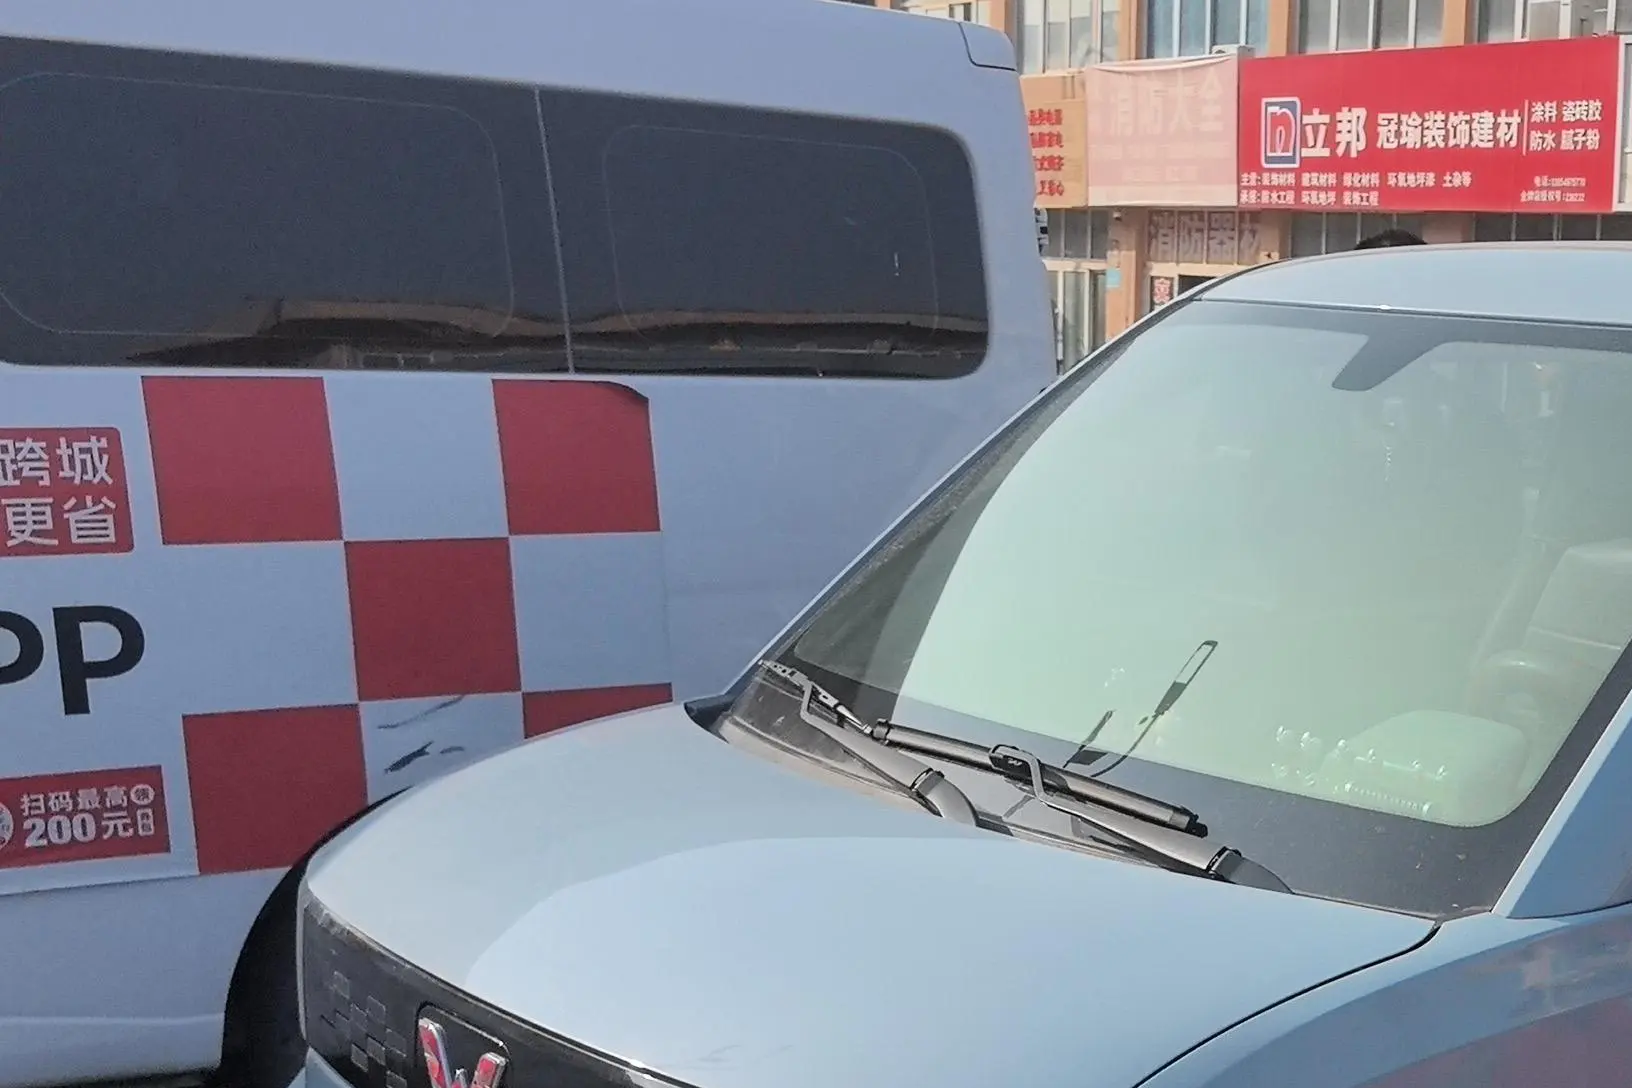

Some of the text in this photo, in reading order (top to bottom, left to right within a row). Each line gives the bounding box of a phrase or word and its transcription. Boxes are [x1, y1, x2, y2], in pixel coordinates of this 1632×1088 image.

[1301, 107, 1367, 158] 立邦
[1376, 109, 1521, 149] 冠瑜装饰建材
[1531, 99, 1602, 123] 涂料 瓷砖胶
[1529, 130, 1556, 151] 防水
[0, 435, 113, 488] 跨城
[1, 495, 118, 548] 更省
